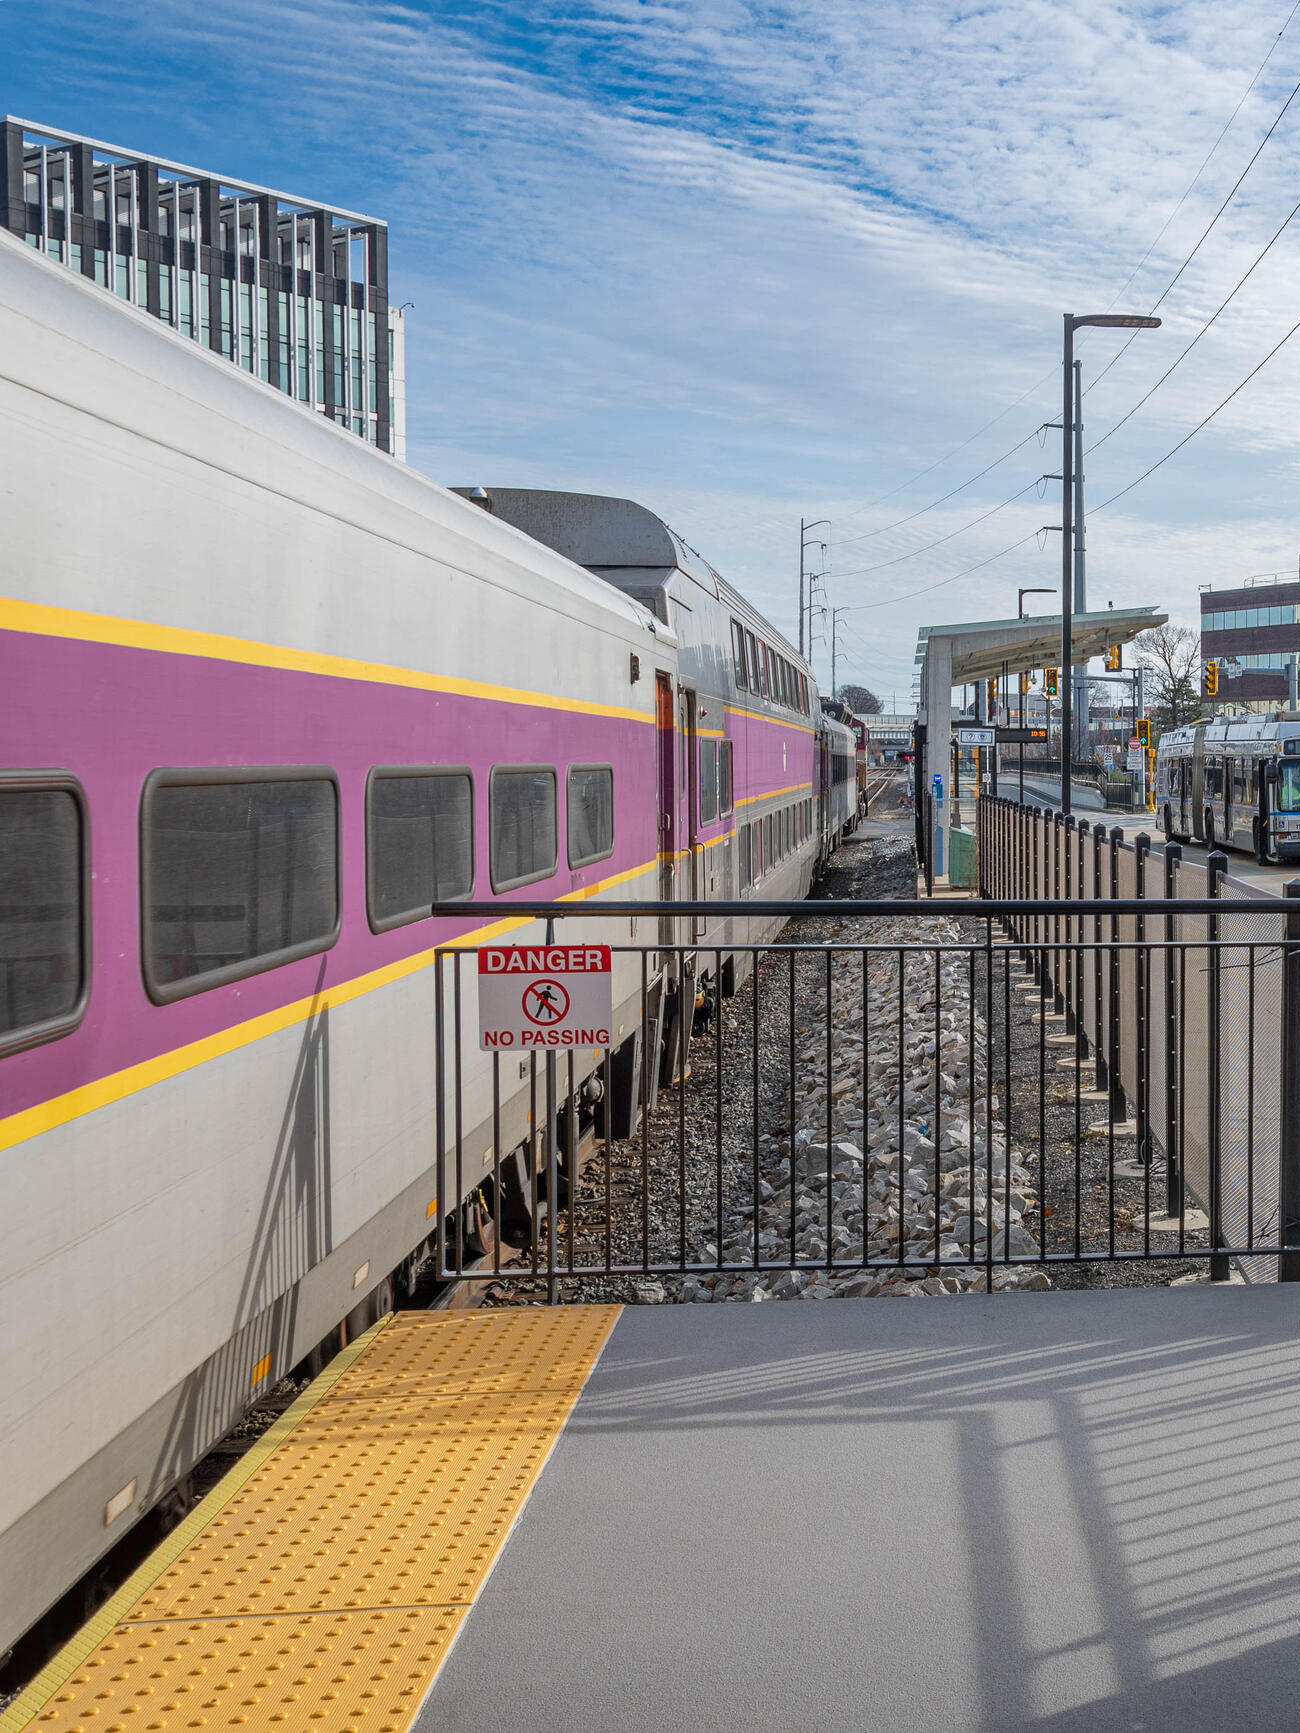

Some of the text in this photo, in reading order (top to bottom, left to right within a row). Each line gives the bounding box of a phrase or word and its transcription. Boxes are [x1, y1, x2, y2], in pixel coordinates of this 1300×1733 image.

[487, 950, 603, 972] DANGER
[484, 1029, 610, 1046] NO PASSING
